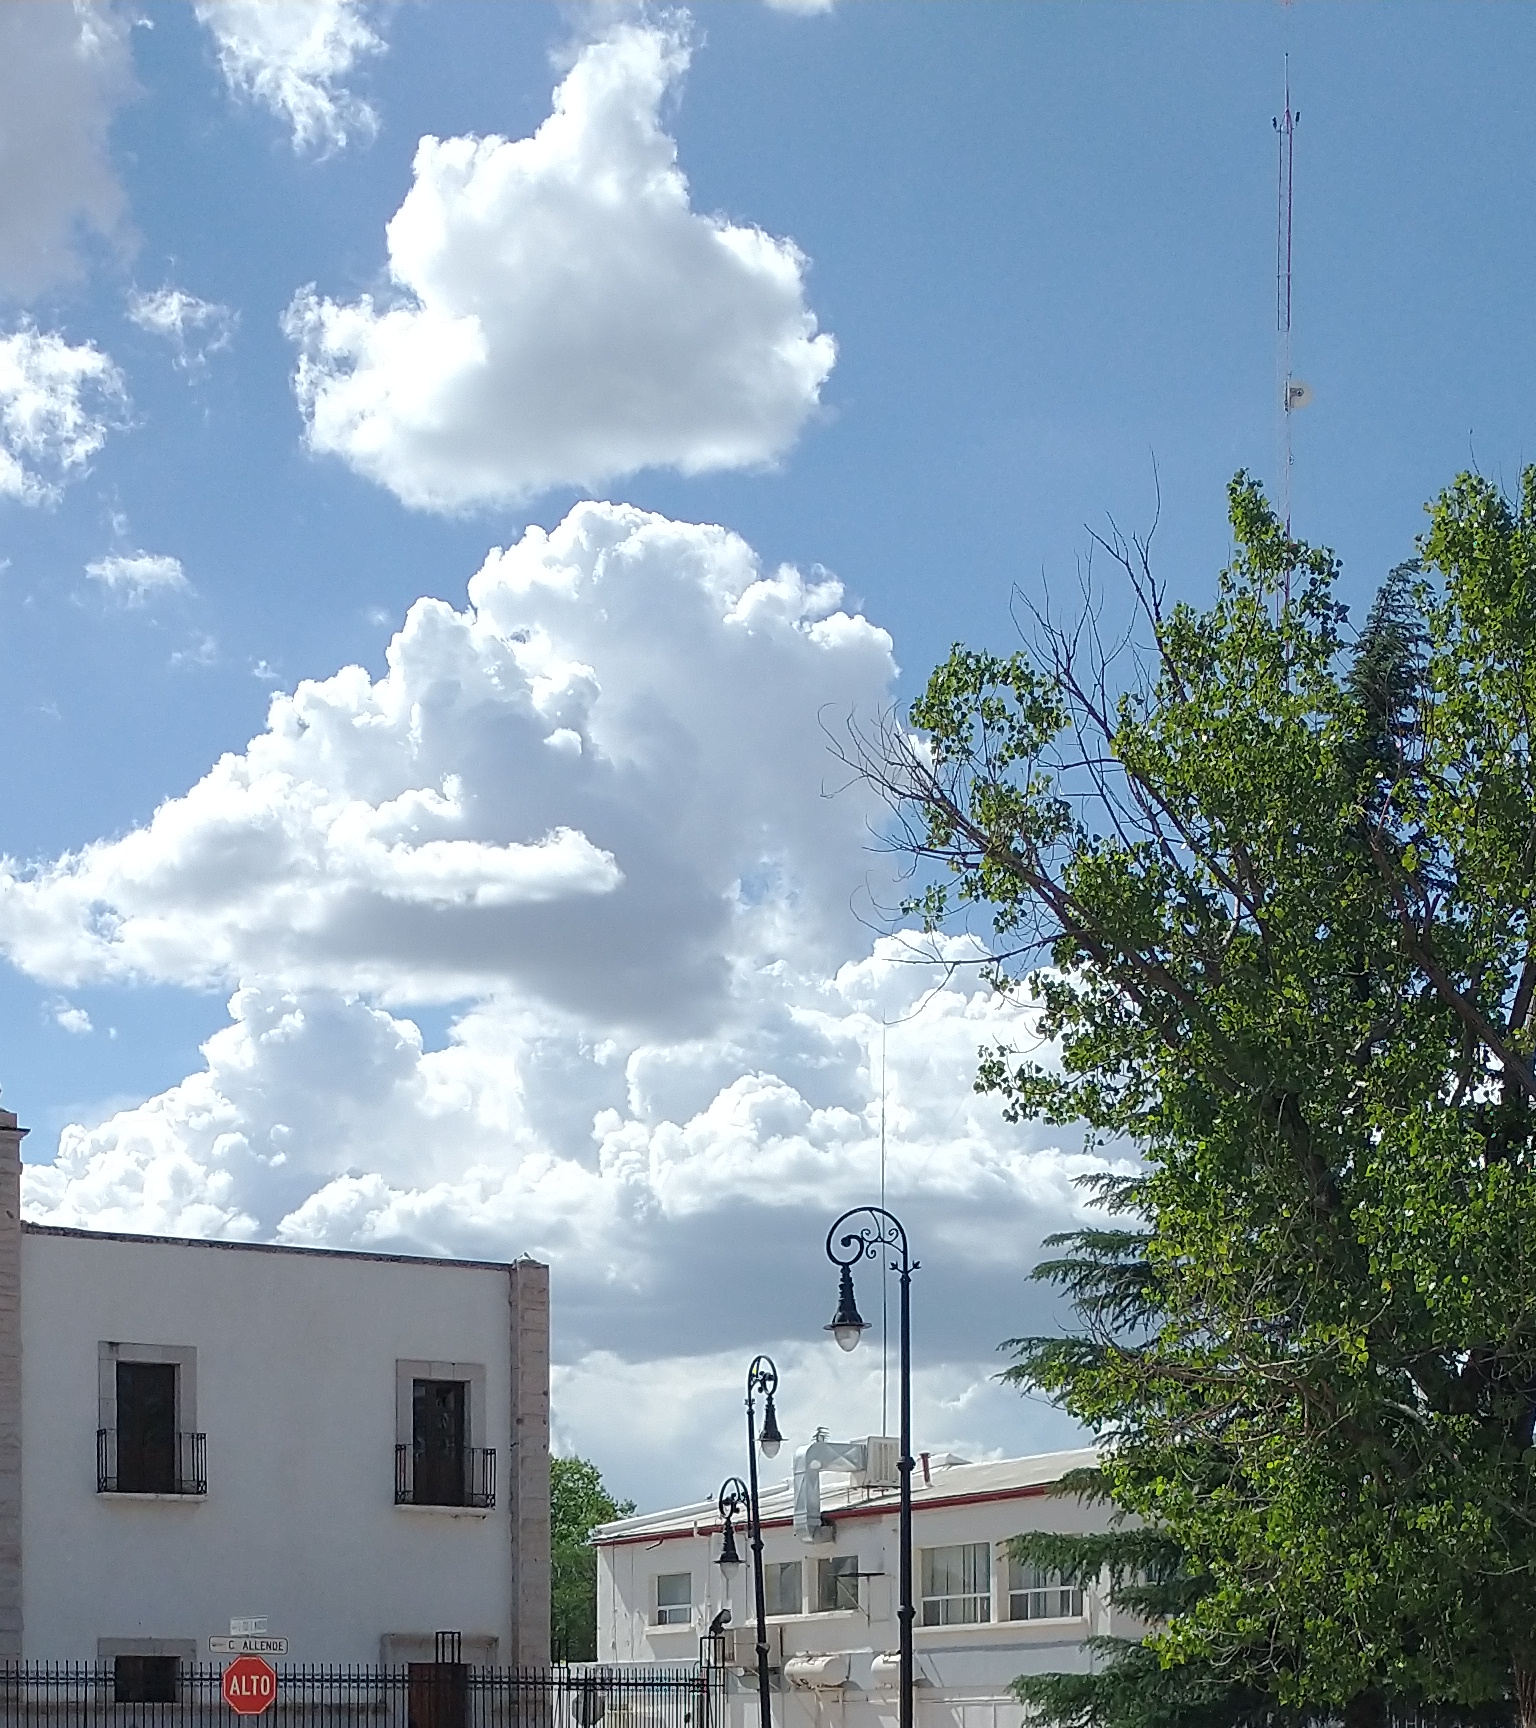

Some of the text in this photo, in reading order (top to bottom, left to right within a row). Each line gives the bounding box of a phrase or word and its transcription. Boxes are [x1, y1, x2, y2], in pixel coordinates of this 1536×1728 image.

[228, 1640, 284, 1651] C ALLENDE
[229, 1674, 271, 1697] ALTO
